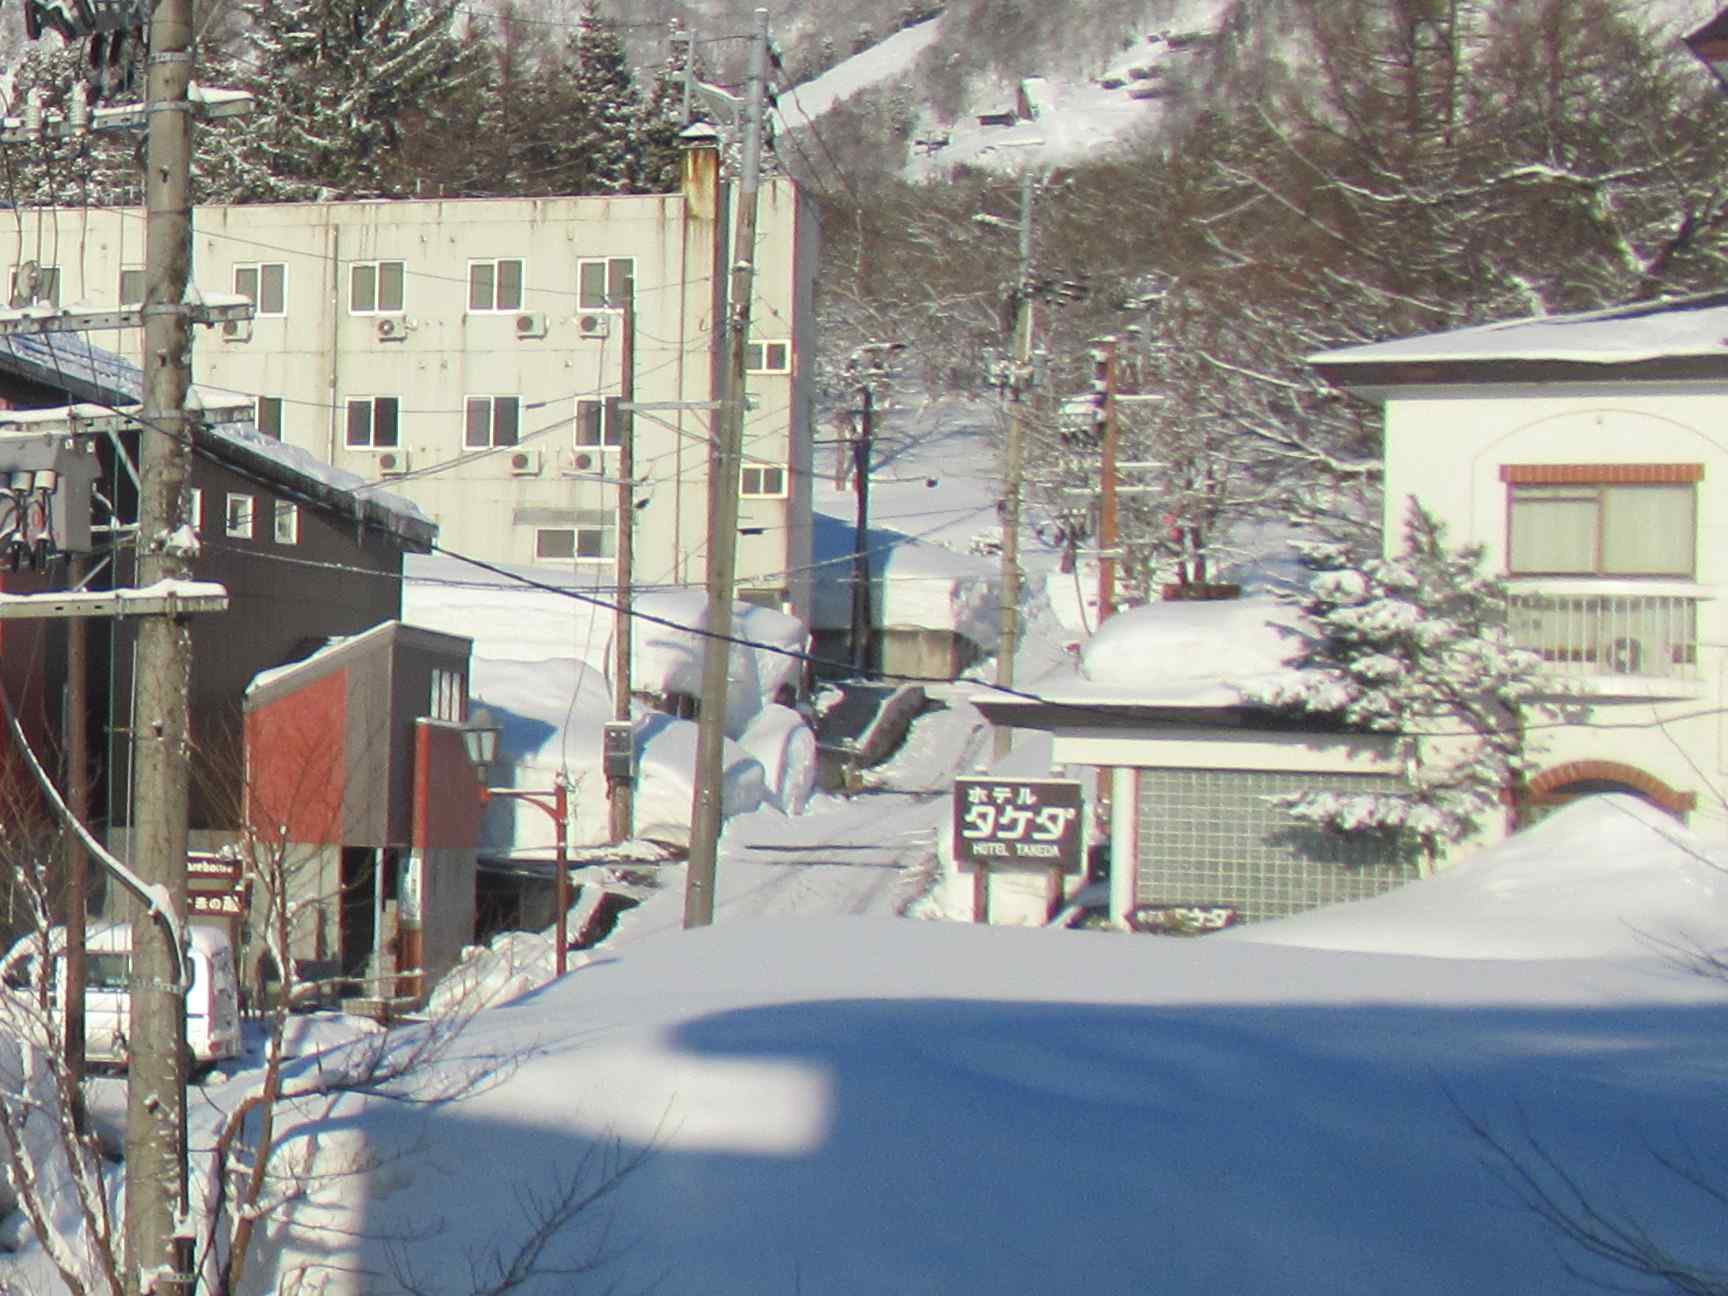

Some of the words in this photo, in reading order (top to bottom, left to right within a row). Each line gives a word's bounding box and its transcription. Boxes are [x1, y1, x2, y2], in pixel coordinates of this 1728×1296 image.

[967, 786, 1037, 805] ホテル
[962, 805, 1076, 840] タケダ
[972, 842, 1010, 857] HOTEL
[1016, 843, 1060, 857] TAKEDA
